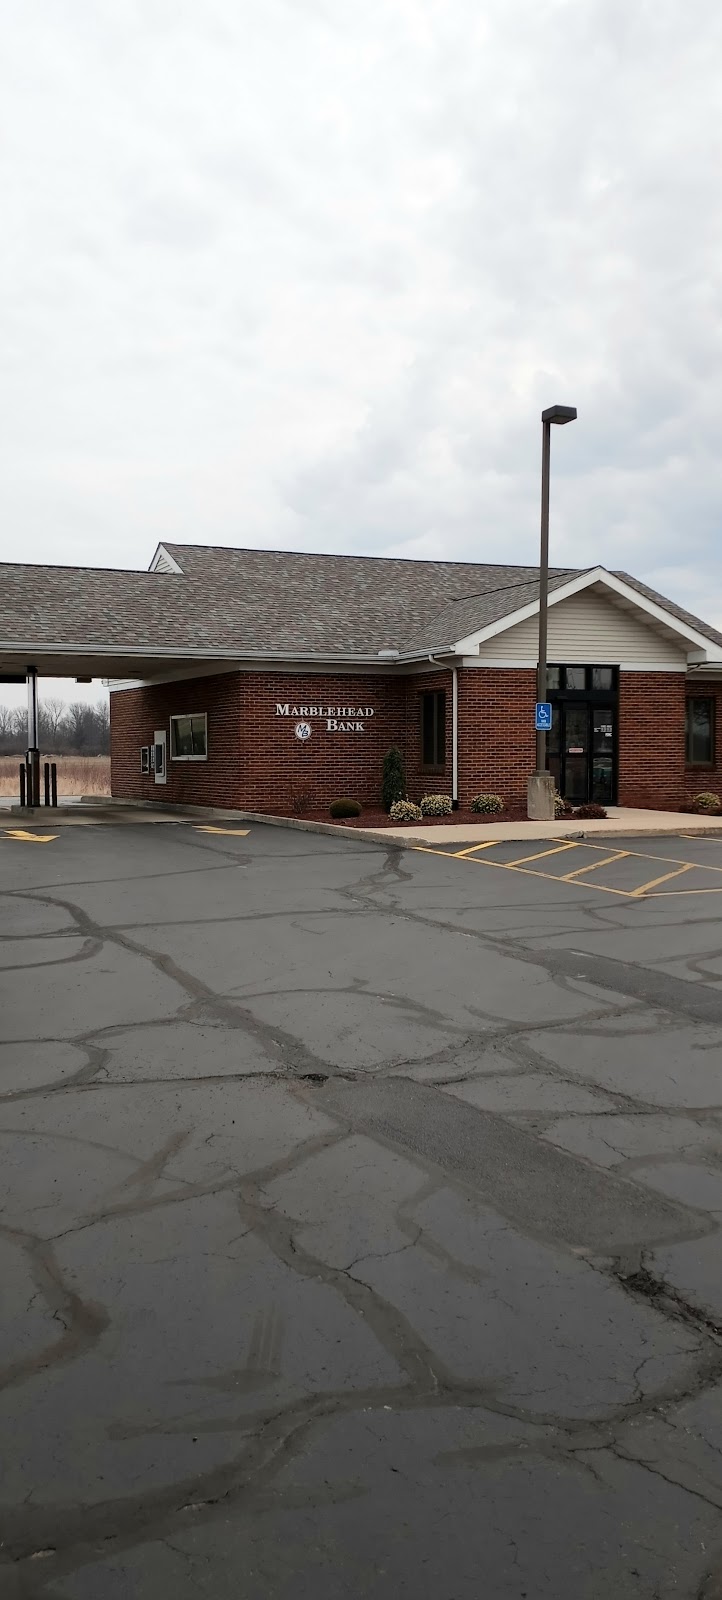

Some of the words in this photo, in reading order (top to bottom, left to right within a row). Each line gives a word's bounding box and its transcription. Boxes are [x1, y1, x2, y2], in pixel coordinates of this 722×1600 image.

[275, 703, 375, 717] MARBLEHEAD
[297, 724, 309, 738] MB
[325, 718, 365, 732] BANK
